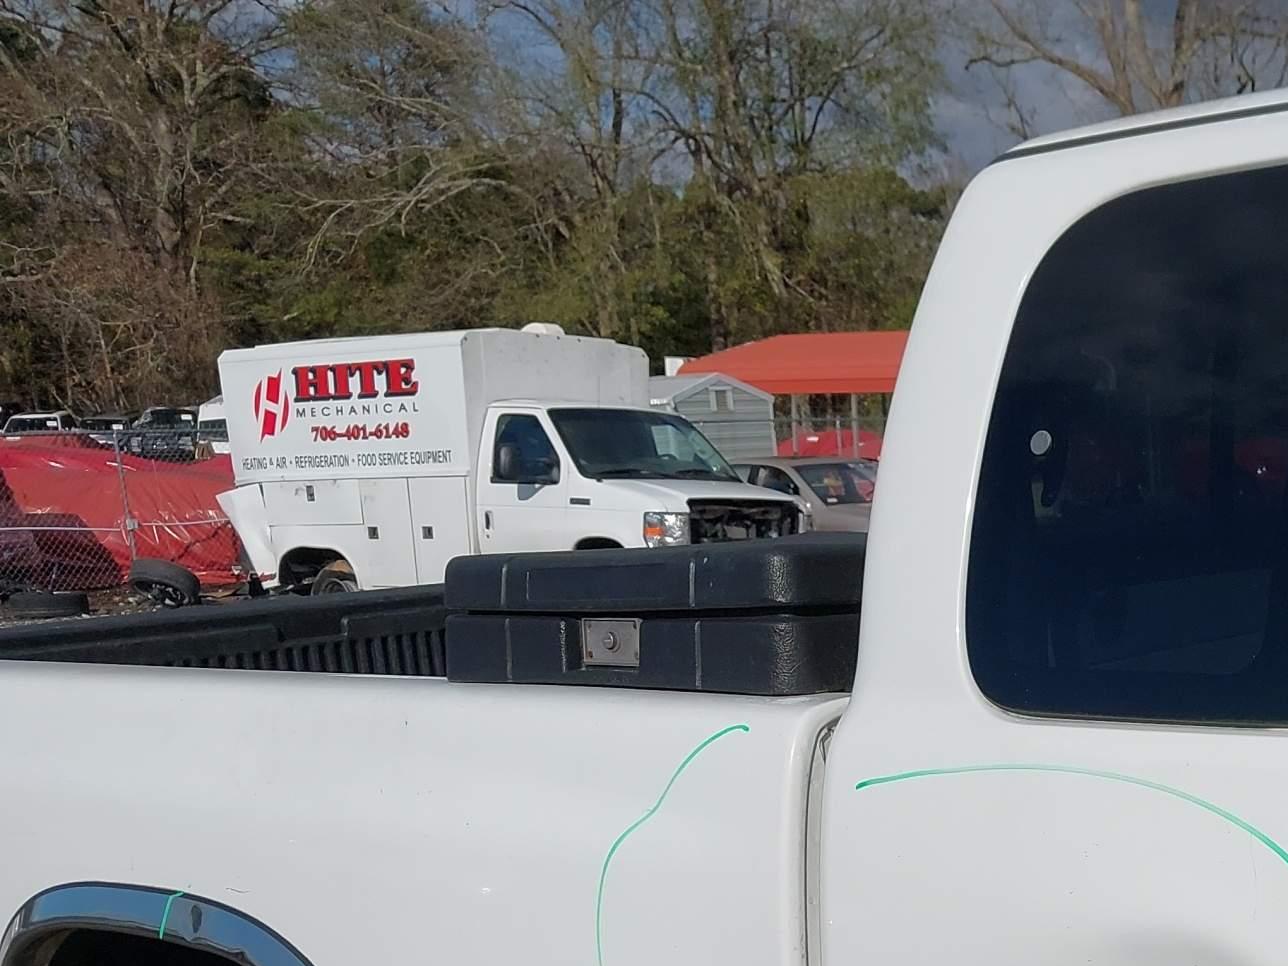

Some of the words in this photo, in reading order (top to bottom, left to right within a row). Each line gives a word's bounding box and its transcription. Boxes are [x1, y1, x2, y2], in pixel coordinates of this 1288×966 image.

[291, 358, 419, 403] HITE
[296, 402, 420, 418] MECHANICAL
[311, 422, 410, 442] 706-401-6148
[242, 457, 268, 470] HEATING
[275, 456, 288, 469] AIR
[294, 454, 350, 469] REFRIGERATION
[357, 452, 377, 467] FOOD
[378, 451, 409, 466] SERVICE
[410, 449, 452, 465] EQUIPMENT
